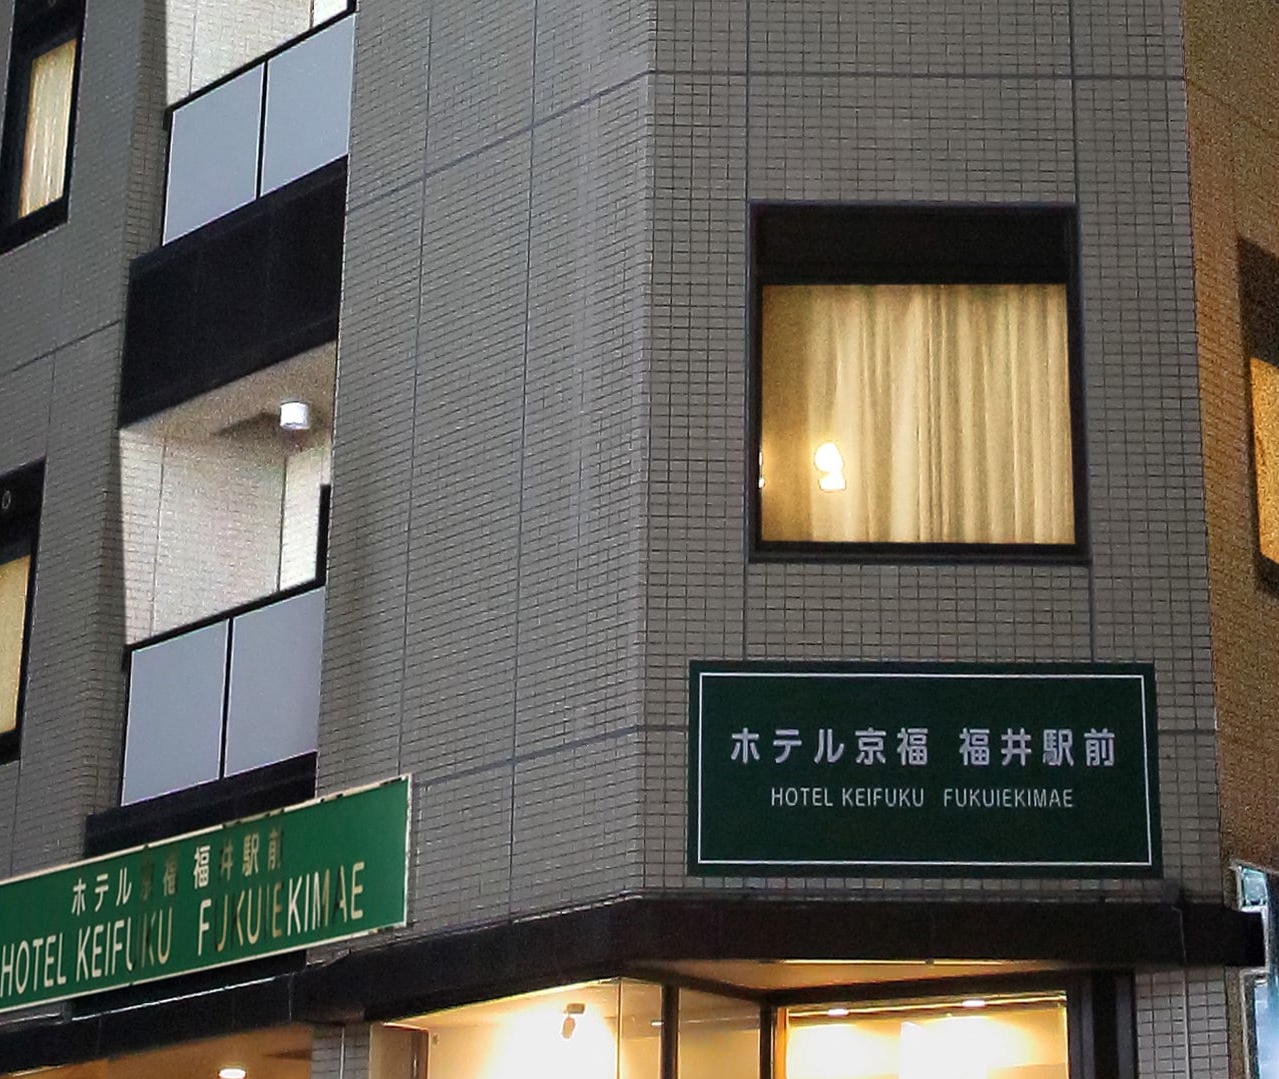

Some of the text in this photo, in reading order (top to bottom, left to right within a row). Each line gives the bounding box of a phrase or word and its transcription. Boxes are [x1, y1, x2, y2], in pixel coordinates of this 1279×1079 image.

[730, 727, 1116, 767] ホテル京福 福井駅前
[771, 787, 1074, 809] HOTEL KEIFUKU FUKUIEKIMAE
[71, 858, 177, 916] ホテル福
[0, 932, 66, 998] HOTEL
[76, 907, 173, 982] KEIFUKU
